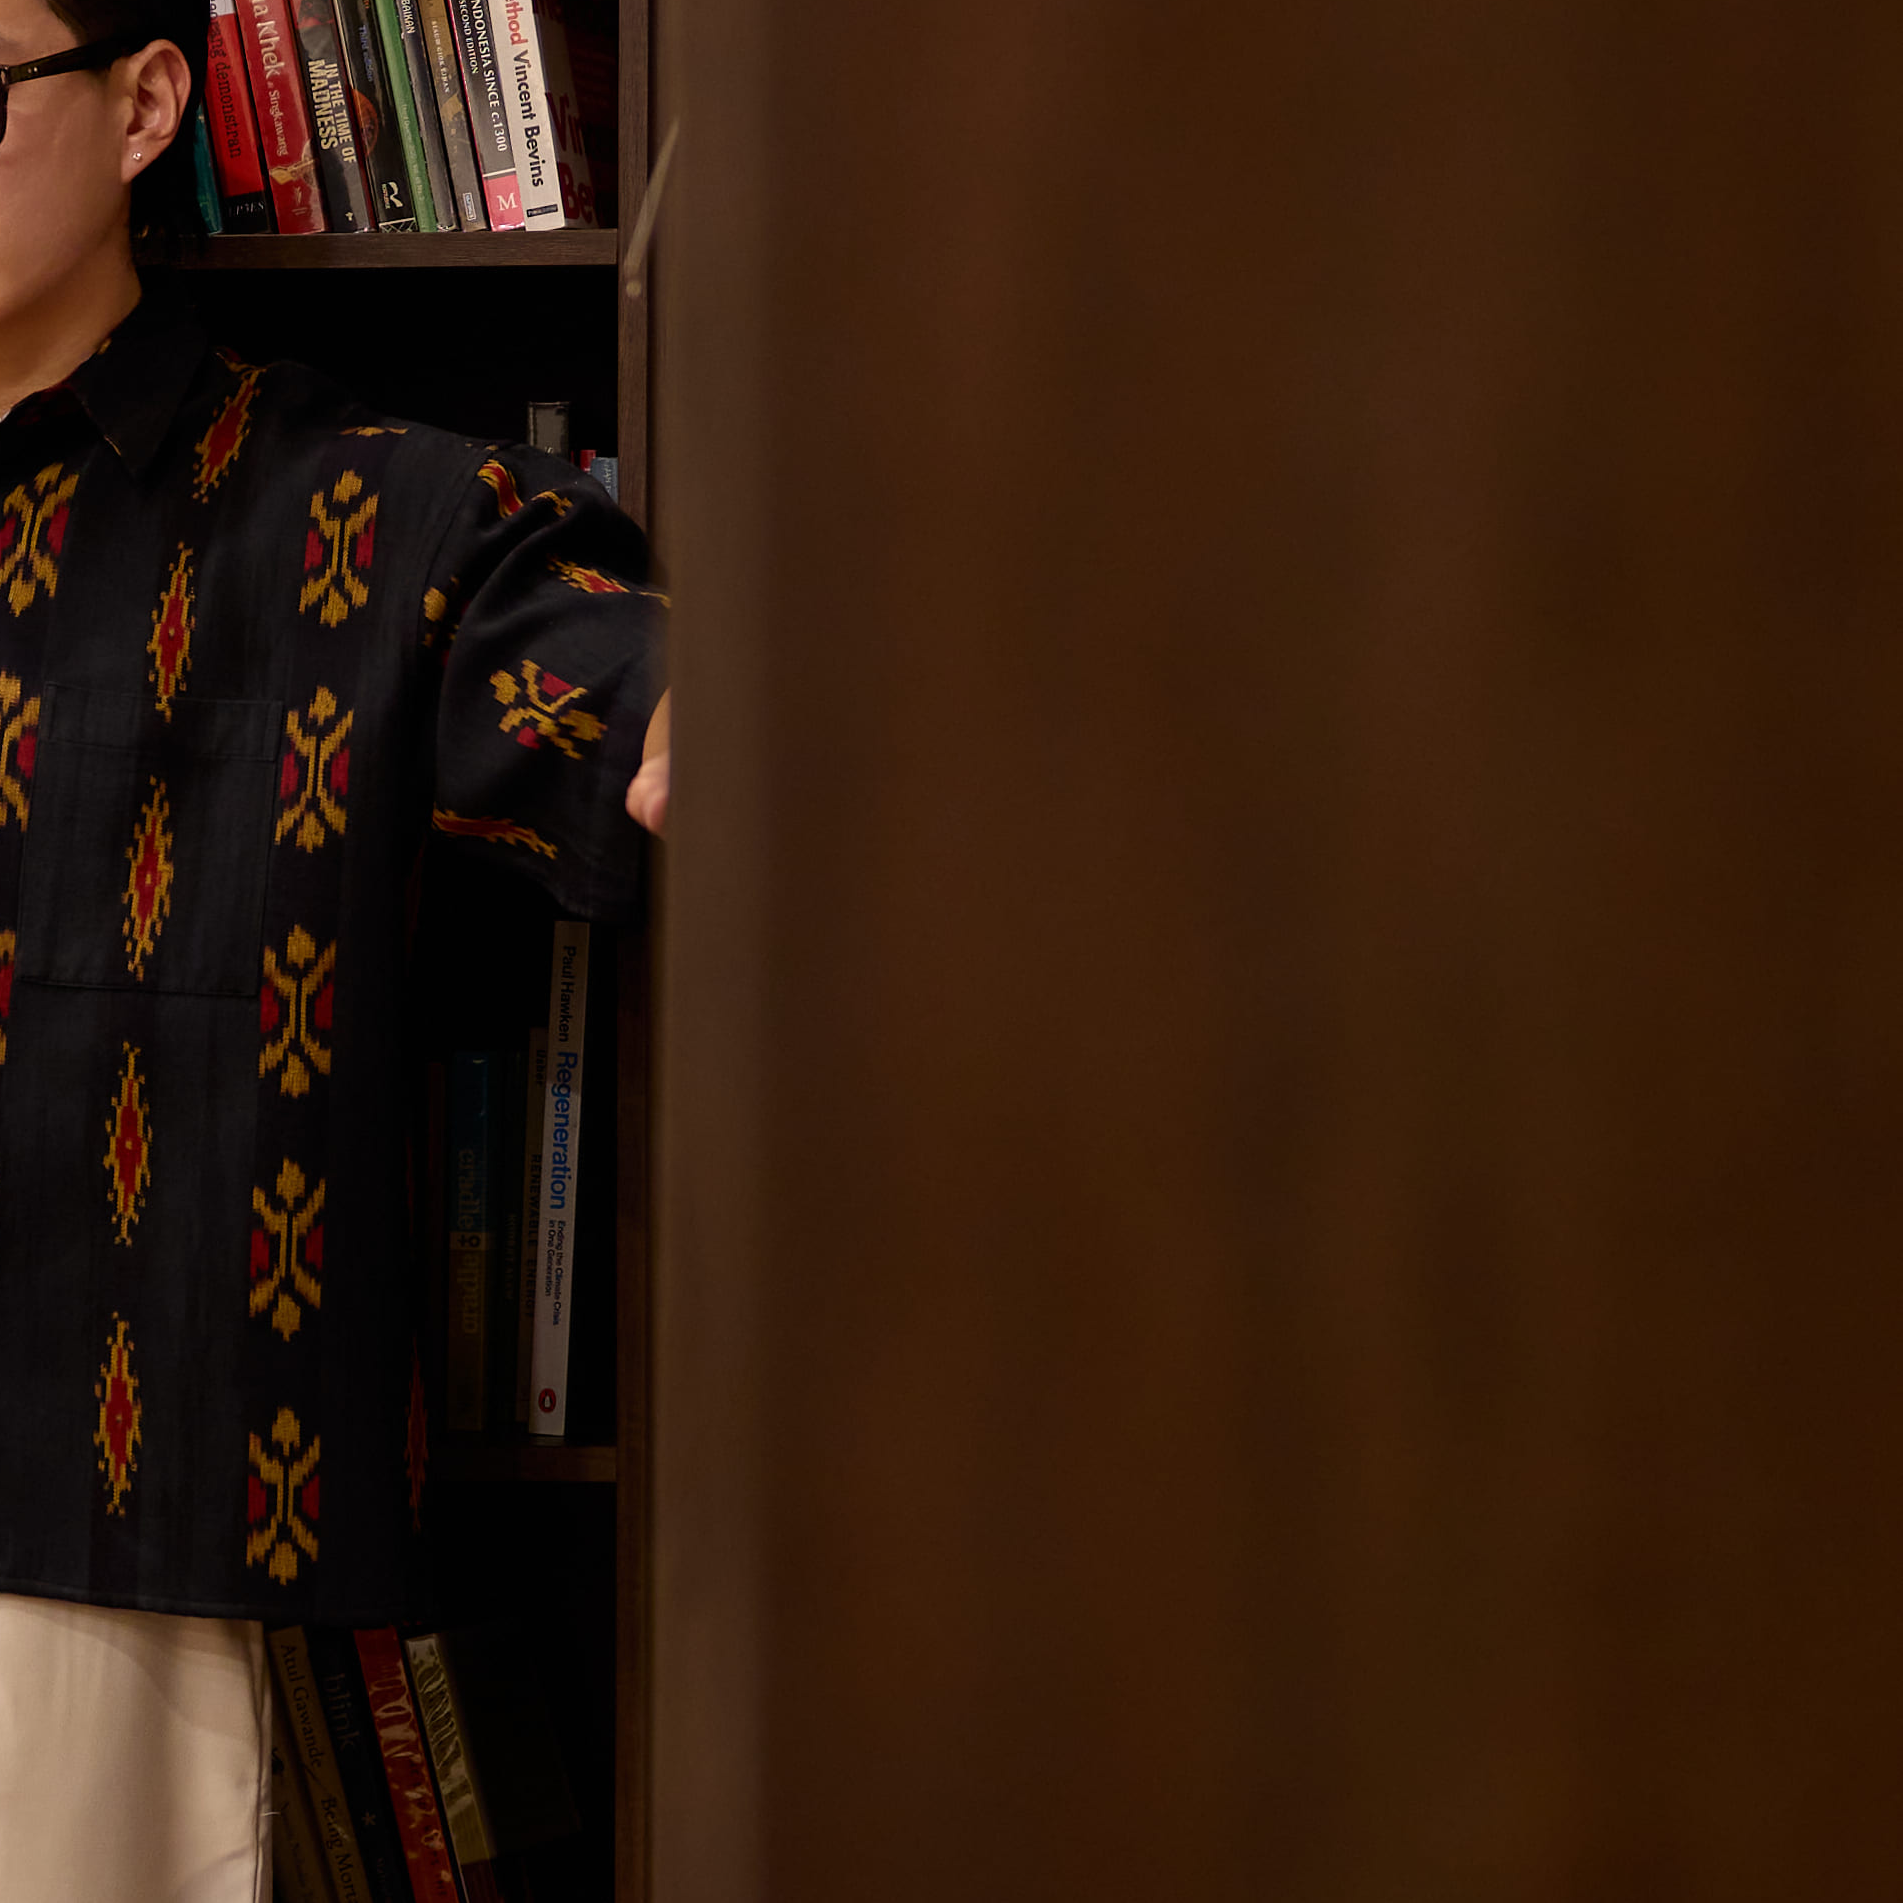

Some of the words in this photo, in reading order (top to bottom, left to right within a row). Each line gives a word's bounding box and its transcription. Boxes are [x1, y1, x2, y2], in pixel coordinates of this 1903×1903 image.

[513, 50, 534, 120] Vincent
[525, 125, 546, 187] Bevins
[561, 946, 577, 979] Paul
[557, 982, 574, 1042] Hawken
[549, 1051, 578, 1209] Regeneration
[280, 1643, 303, 1682] Atul
[293, 1687, 325, 1770] Gawande
[320, 1797, 347, 1850] Being
